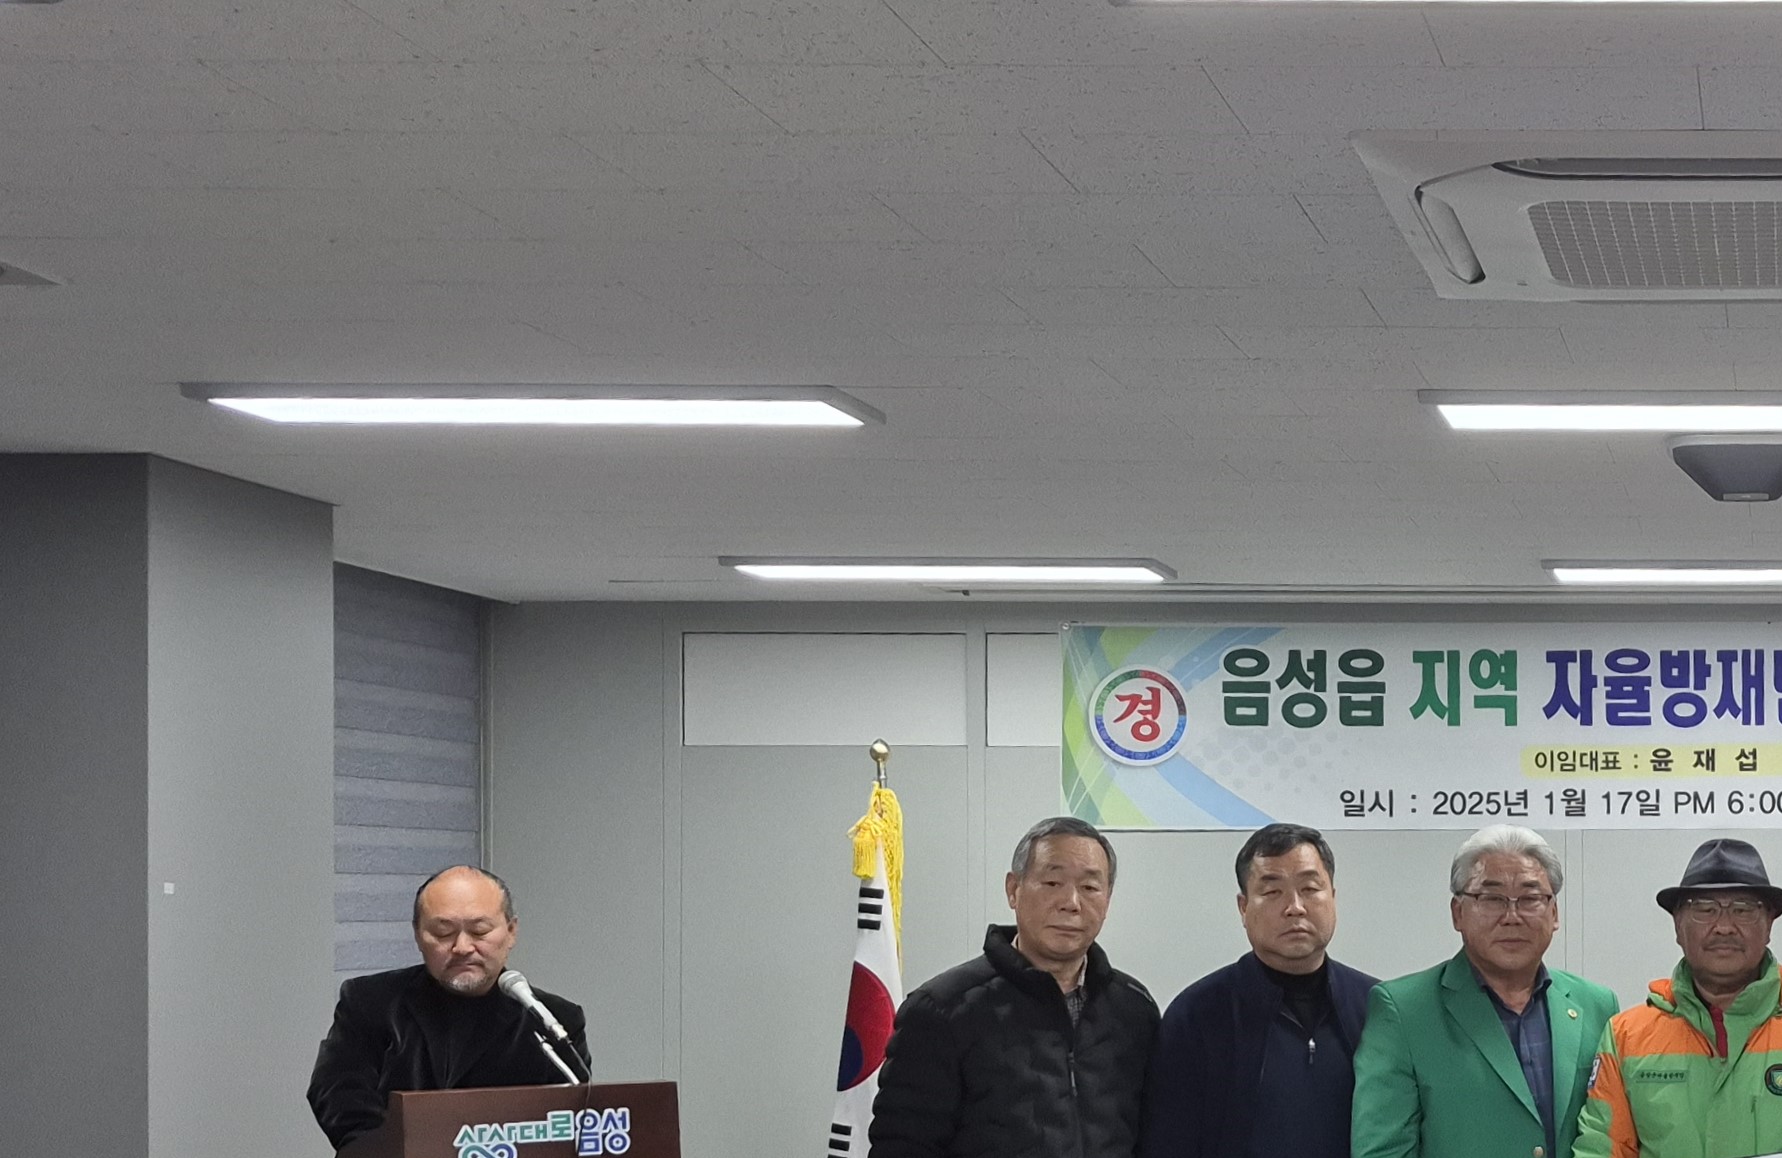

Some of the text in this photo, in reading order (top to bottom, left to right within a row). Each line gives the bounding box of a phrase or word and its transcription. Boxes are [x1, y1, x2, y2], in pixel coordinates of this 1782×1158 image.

[1222, 648, 1386, 728] 음성읍
[1410, 649, 1517, 726] 지역
[1114, 687, 1162, 742] 경
[1535, 750, 1622, 772] 이임대표
[1340, 790, 1393, 817] 일시
[1433, 789, 1528, 816] 2025년
[1545, 789, 1586, 817] 1월
[1602, 789, 1660, 816] 17일
[1674, 791, 1714, 814] PM
[575, 1107, 631, 1157] 음성
